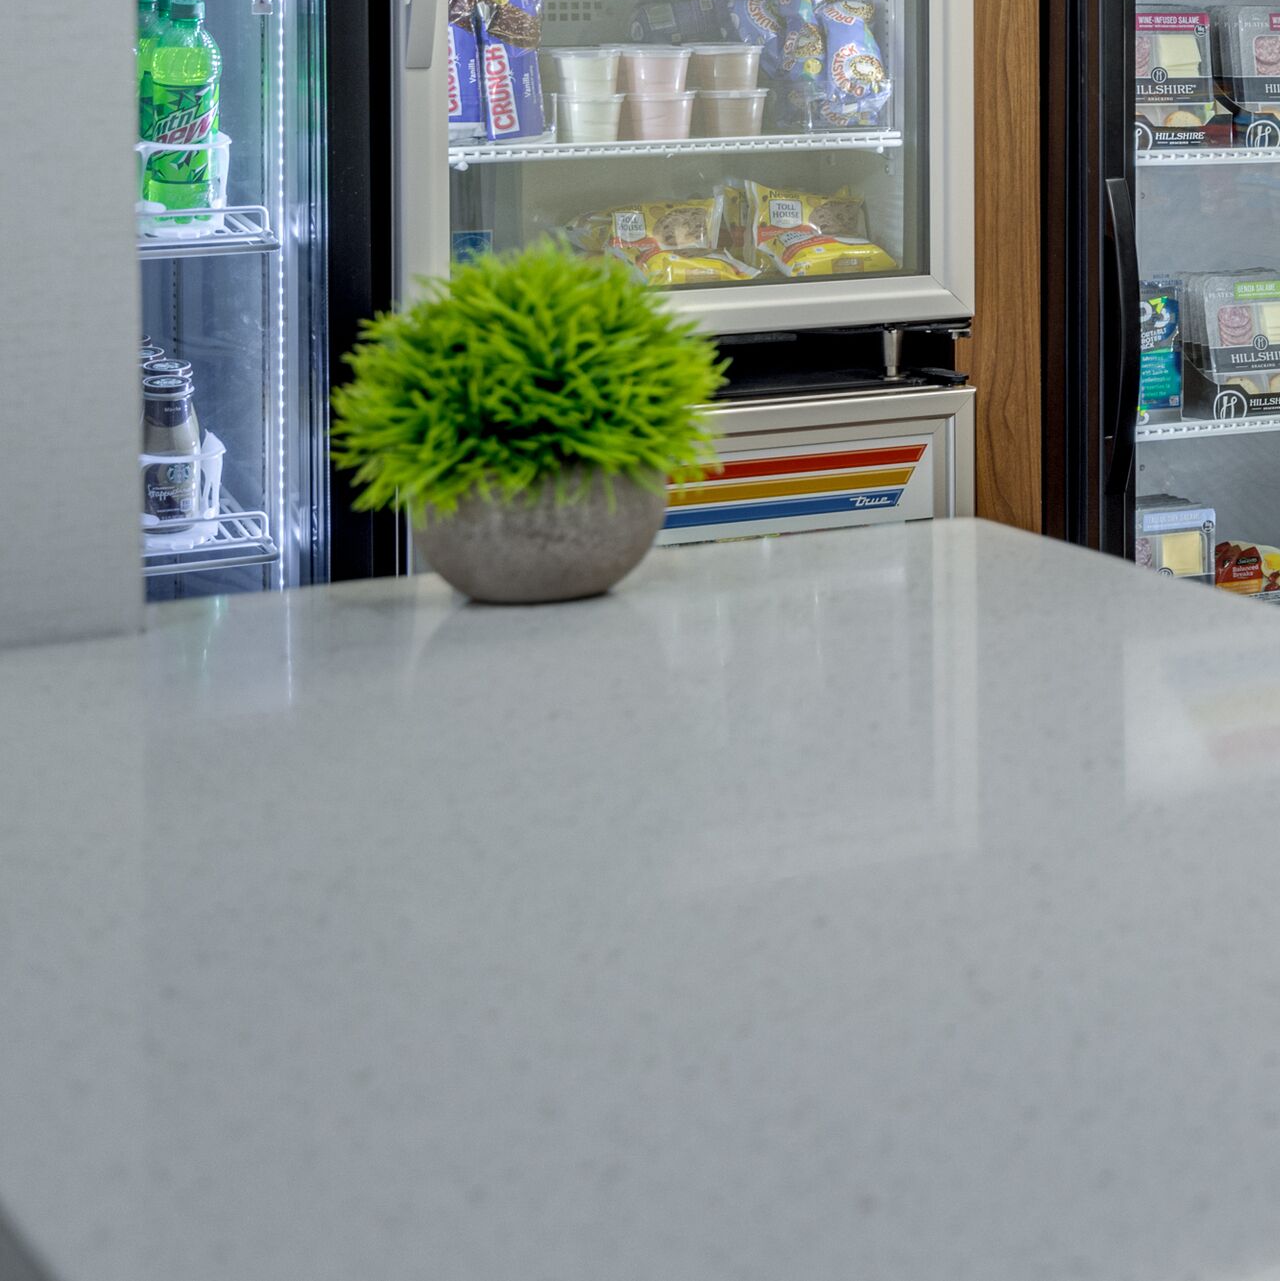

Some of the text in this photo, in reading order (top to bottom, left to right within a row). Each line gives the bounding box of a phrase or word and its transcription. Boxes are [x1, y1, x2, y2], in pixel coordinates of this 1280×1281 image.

[1138, 16, 1200, 24] WINE-INFUSED SALAME
[486, 46, 516, 131] CRUNCH
[1136, 84, 1194, 95] ILLSHIRE
[1155, 132, 1204, 140] HILLSHIRE
[776, 202, 797, 211] TOLL
[772, 210, 800, 219] HOUSE
